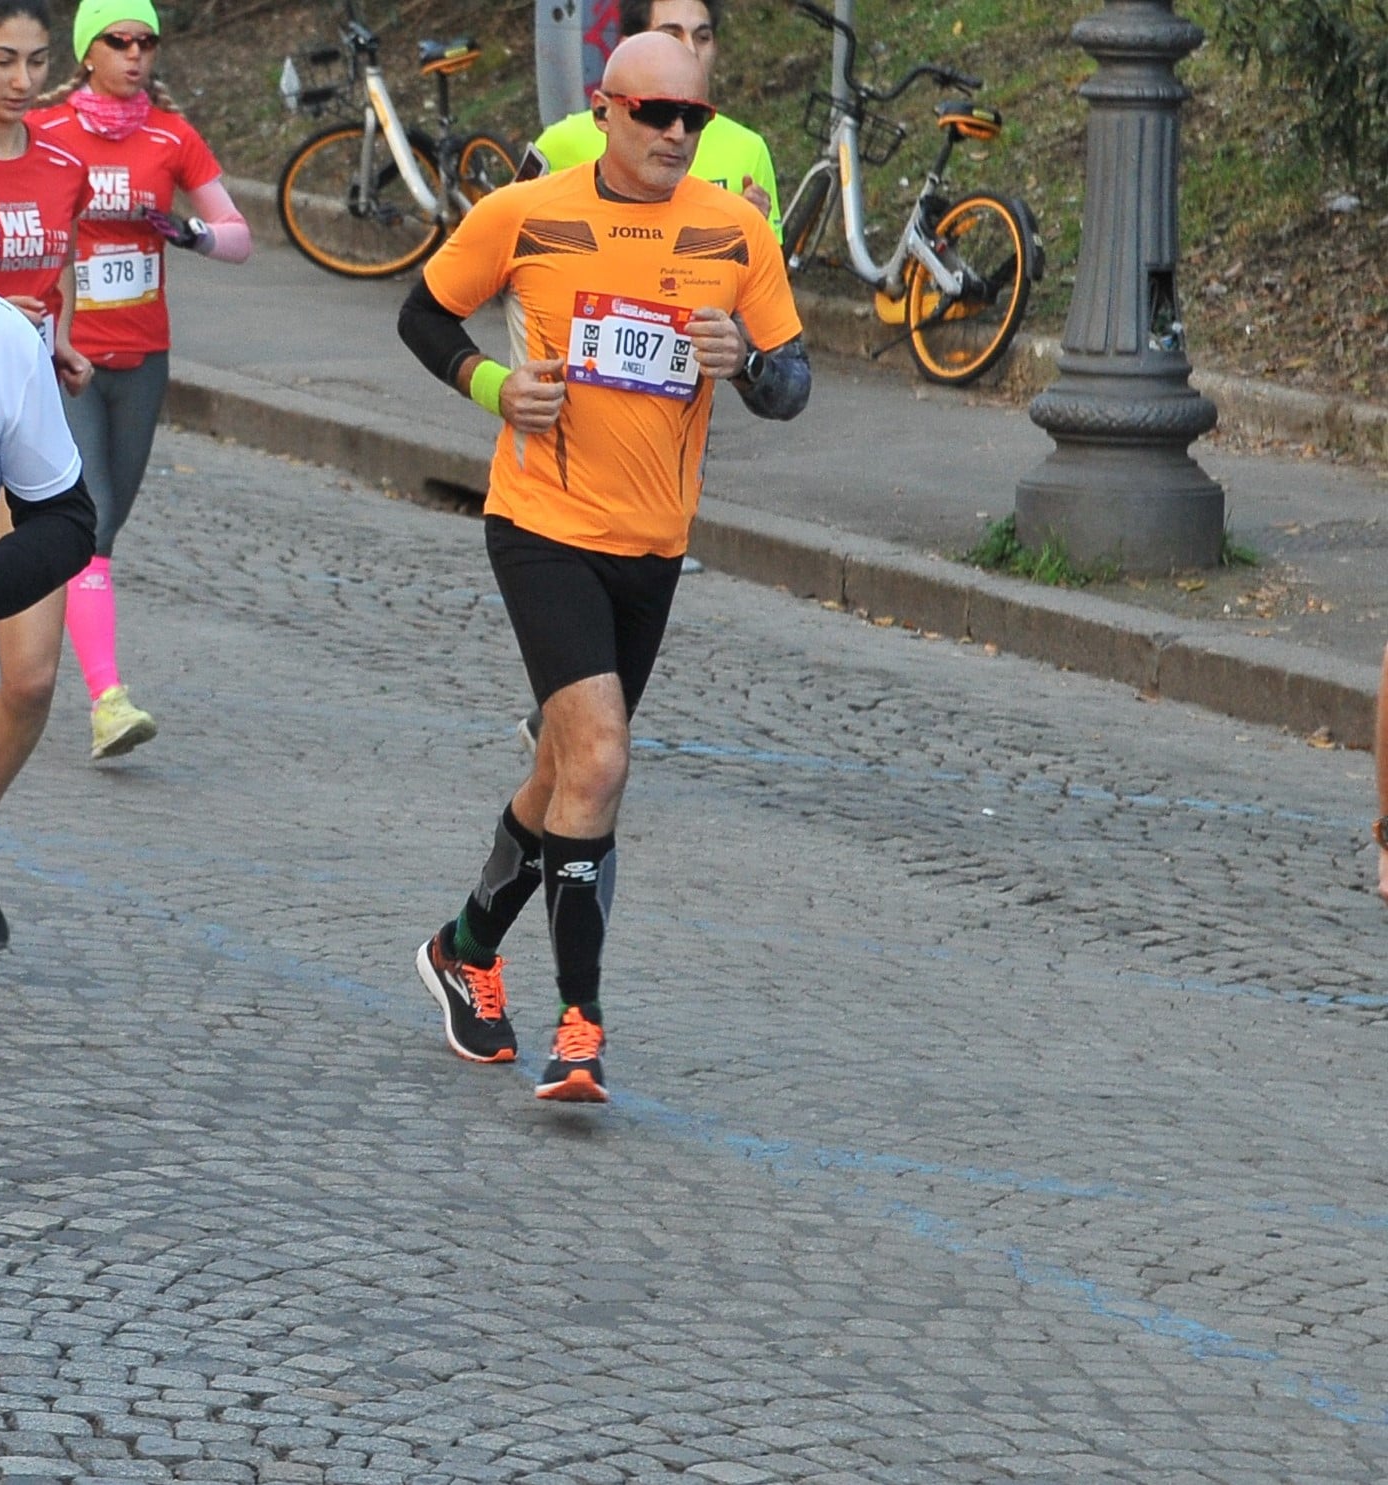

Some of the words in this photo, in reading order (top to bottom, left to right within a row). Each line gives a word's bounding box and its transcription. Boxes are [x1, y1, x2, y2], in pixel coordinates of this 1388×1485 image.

[87, 173, 130, 194] WE
[88, 194, 130, 211] RUN
[2, 237, 45, 258] RUN
[102, 260, 135, 285] 378
[614, 326, 665, 361] 1087
